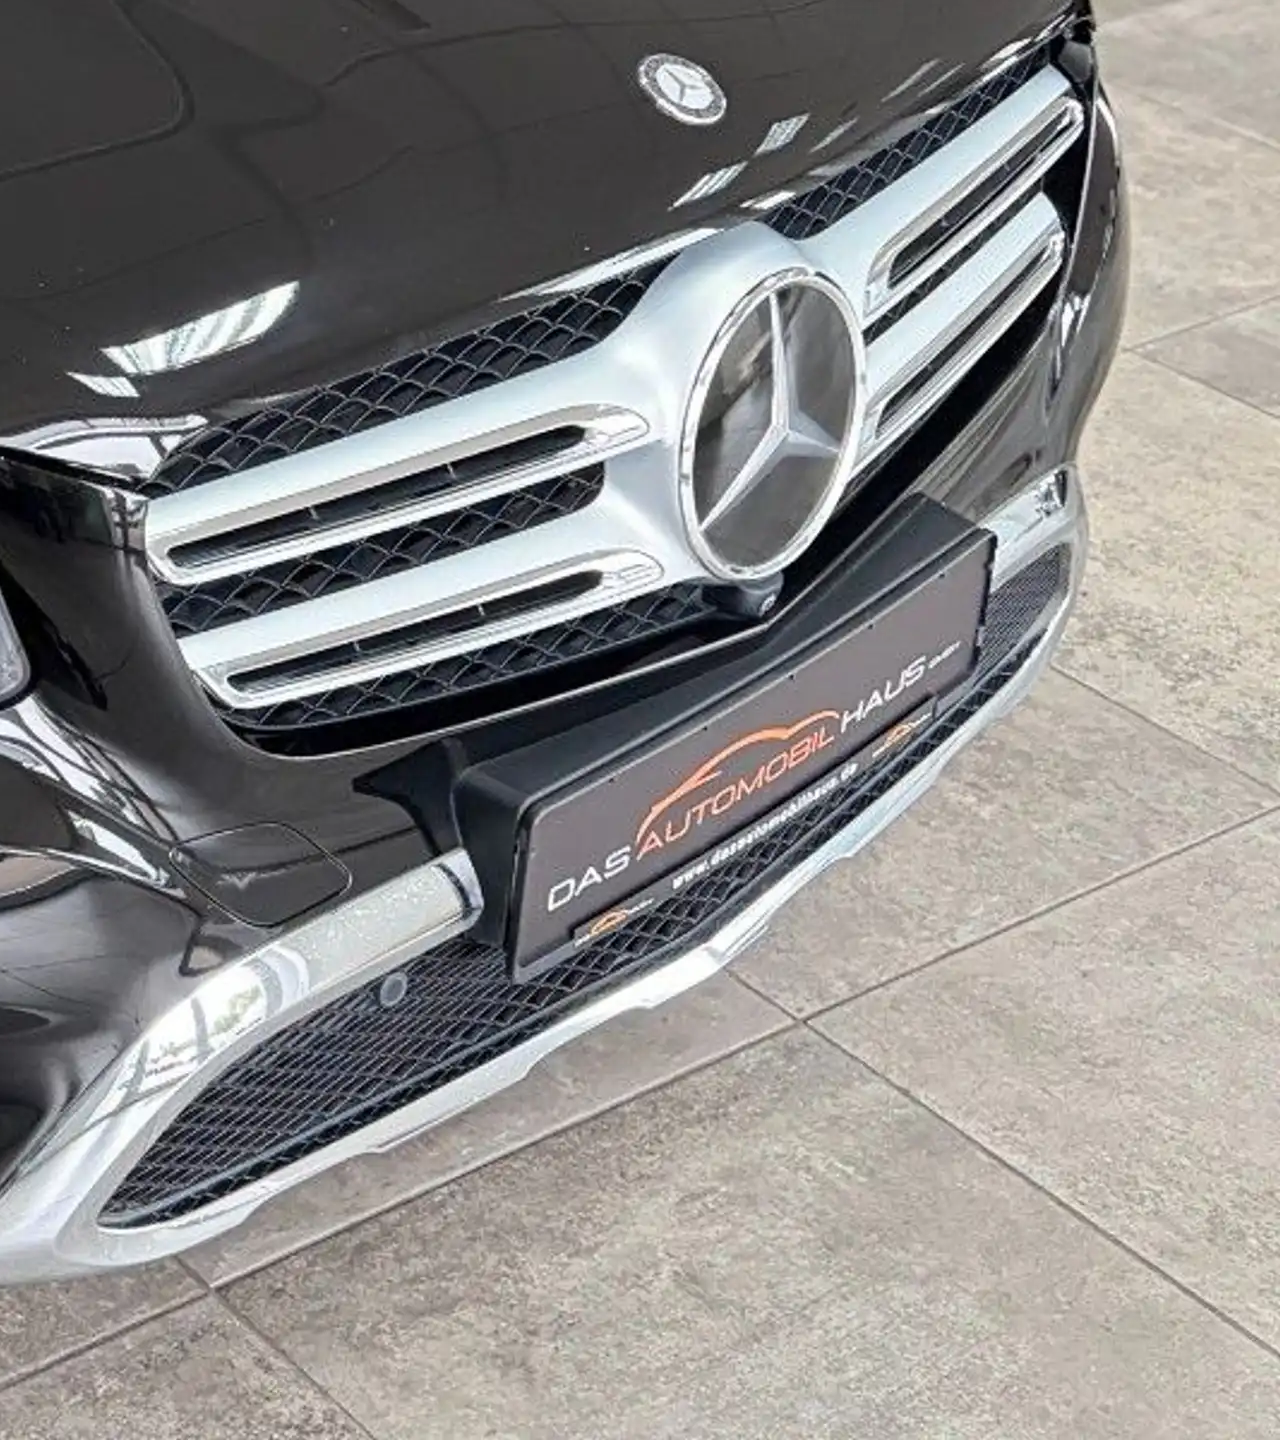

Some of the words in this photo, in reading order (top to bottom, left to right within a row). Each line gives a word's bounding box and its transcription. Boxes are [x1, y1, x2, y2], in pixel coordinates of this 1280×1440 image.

[547, 845, 631, 912] DAS
[636, 726, 835, 861] AUTOMOBIL
[840, 655, 927, 733] HAUS
